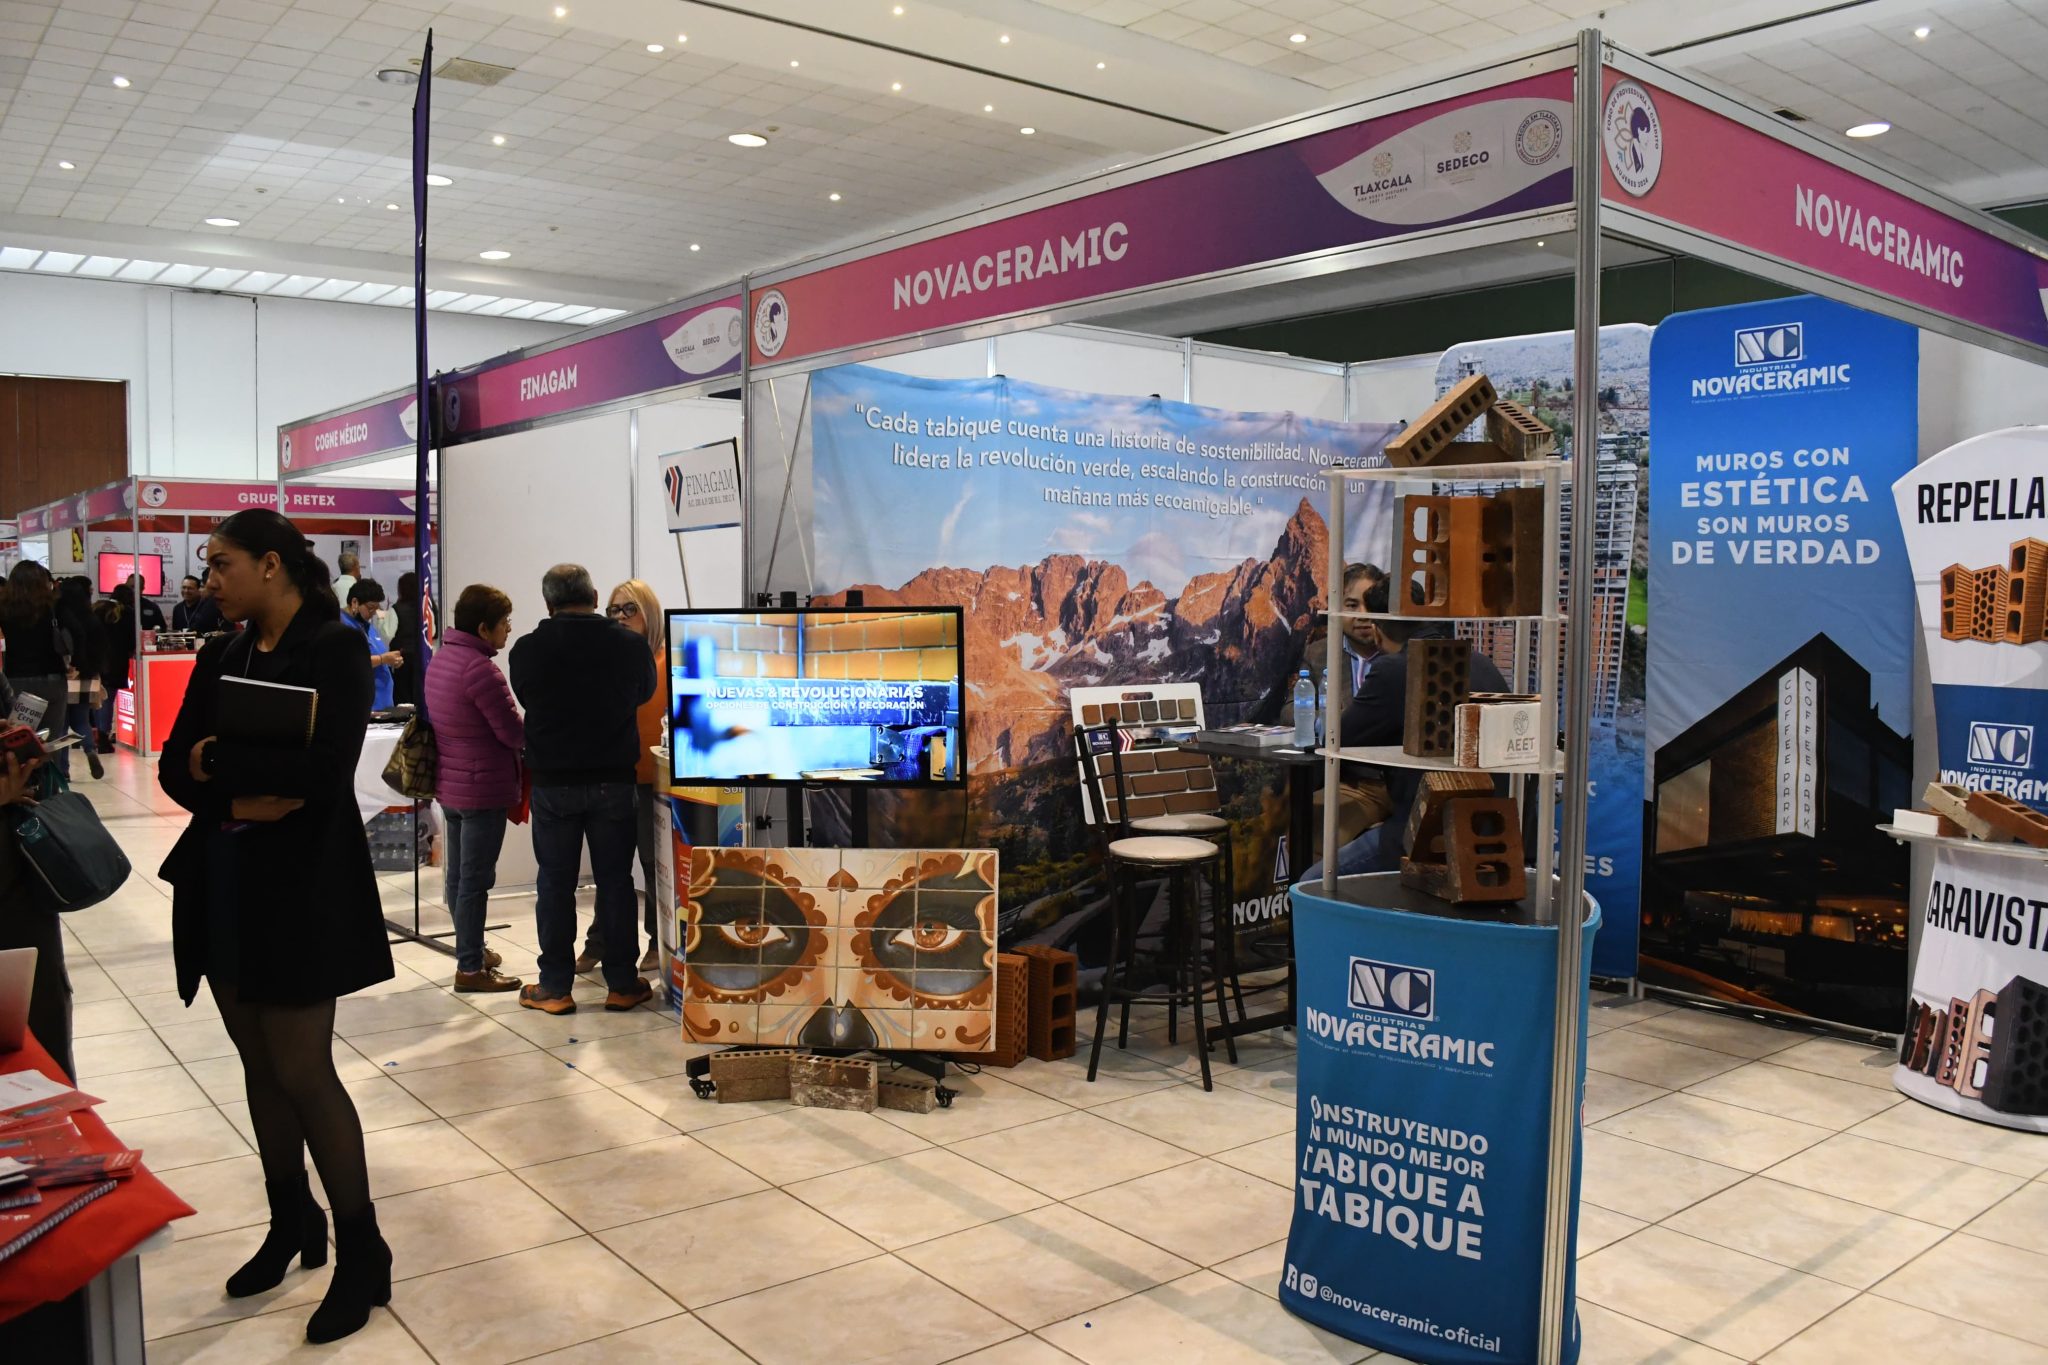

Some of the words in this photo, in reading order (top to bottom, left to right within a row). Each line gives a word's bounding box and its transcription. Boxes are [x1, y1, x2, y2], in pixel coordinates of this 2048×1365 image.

[1437, 151, 1490, 174] SEDECO
[1353, 173, 1412, 197] TLAXCALA
[1795, 183, 1964, 288] NOVACERAMIC
[893, 221, 1129, 311] NOVACERAMIC
[520, 364, 578, 402] FINAGAM
[1691, 363, 1851, 398] NOVACERAMIC
[1739, 363, 1797, 374] INDUSTRIAS
[315, 430, 339, 452] COGNE
[339, 422, 368, 447] MÉXICO
[925, 415, 1002, 443] tabique
[1007, 419, 1069, 444] cuenta
[1074, 430, 1105, 448] una
[1110, 428, 1170, 451] historia
[1175, 434, 1196, 455] de
[1200, 441, 1305, 463] sostenibilidad.
[893, 442, 950, 469] lidera
[956, 446, 973, 469] la
[979, 447, 1077, 475] revolución
[1081, 456, 1135, 480] verde,
[1141, 461, 1218, 486] escalando
[1223, 468, 1236, 489] la
[1240, 470, 1326, 492] construcción
[1349, 480, 1365, 494] un
[1696, 451, 1784, 473] MUROS
[1793, 447, 1850, 468] CON
[685, 468, 735, 496] FINAGAM
[1043, 485, 1112, 507] mañana
[1117, 482, 1149, 507] más
[1680, 472, 1870, 508] ESTÉTICA
[293, 494, 336, 506] RETEX
[1917, 476, 2046, 524] REPELLA
[1697, 516, 1748, 535] SON
[1757, 513, 1850, 534] MUROS
[1672, 540, 1715, 565] DE
[1727, 539, 1880, 565] VERDAD
[706, 686, 765, 698] NUEVAS
[767, 686, 777, 698] &
[781, 686, 924, 699] REVOLUCIONARIAS
[771, 699, 848, 711] CONSTRUCCIÓN
[850, 702, 857, 710] Y
[859, 700, 924, 710] DECORACIÓN
[1784, 679, 1793, 765] COFFEE
[1804, 680, 1813, 766] COFFEE
[1507, 737, 1536, 752] AEET
[1970, 766, 2023, 777] INDUSTRIAS
[1782, 772, 1791, 827] PARK
[1803, 773, 1811, 830] PARK
[1306, 1006, 1495, 1068] NOVACERAMIC
[1352, 1012, 1426, 1031] INDUSTRIAS
[1327, 1126, 1405, 1160] MUNDO
[1409, 1146, 1485, 1180] MEJOR
[1302, 1144, 1448, 1209] TABIQUE
[1456, 1183, 1485, 1217] A
[1299, 1176, 1483, 1262] TABIQUE
[1320, 1285, 1501, 1353] @novaceramic.oficial
